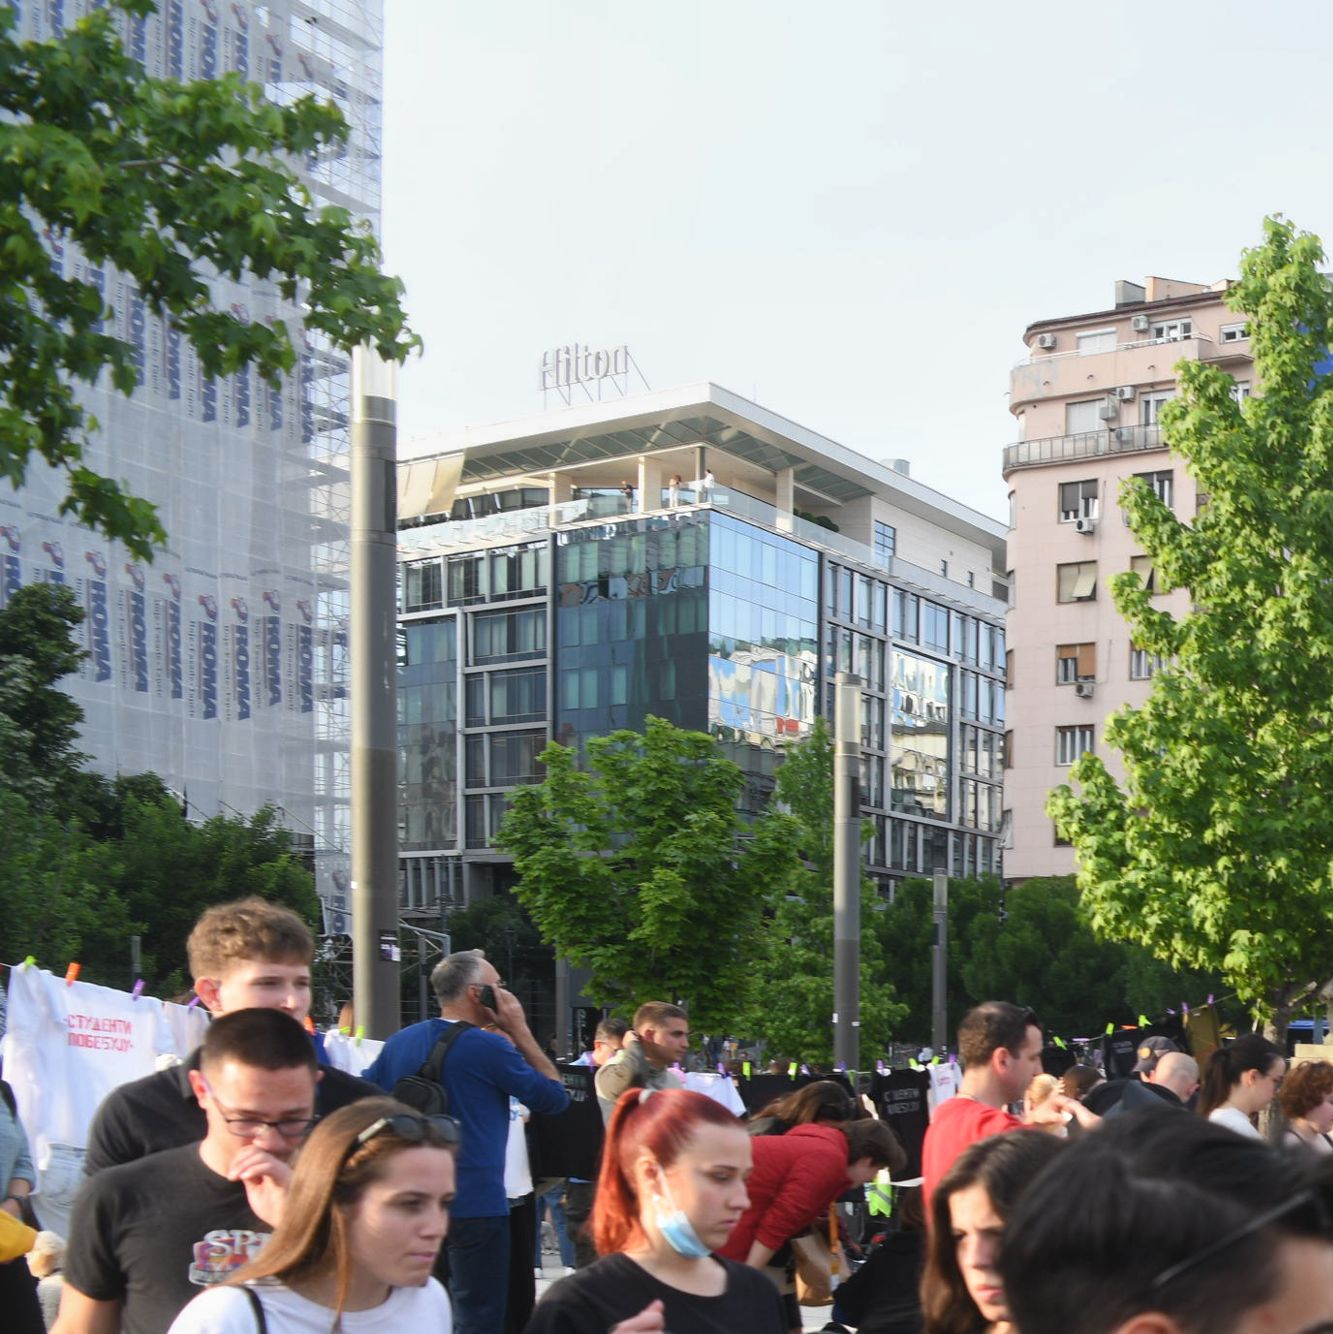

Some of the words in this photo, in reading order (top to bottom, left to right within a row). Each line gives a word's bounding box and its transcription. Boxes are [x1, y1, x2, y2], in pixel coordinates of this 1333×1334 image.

[541, 343, 628, 390] Hilton
[200, 620, 218, 720] ROMA
[235, 625, 251, 721] ROMA
[297, 624, 314, 714] ROMA
